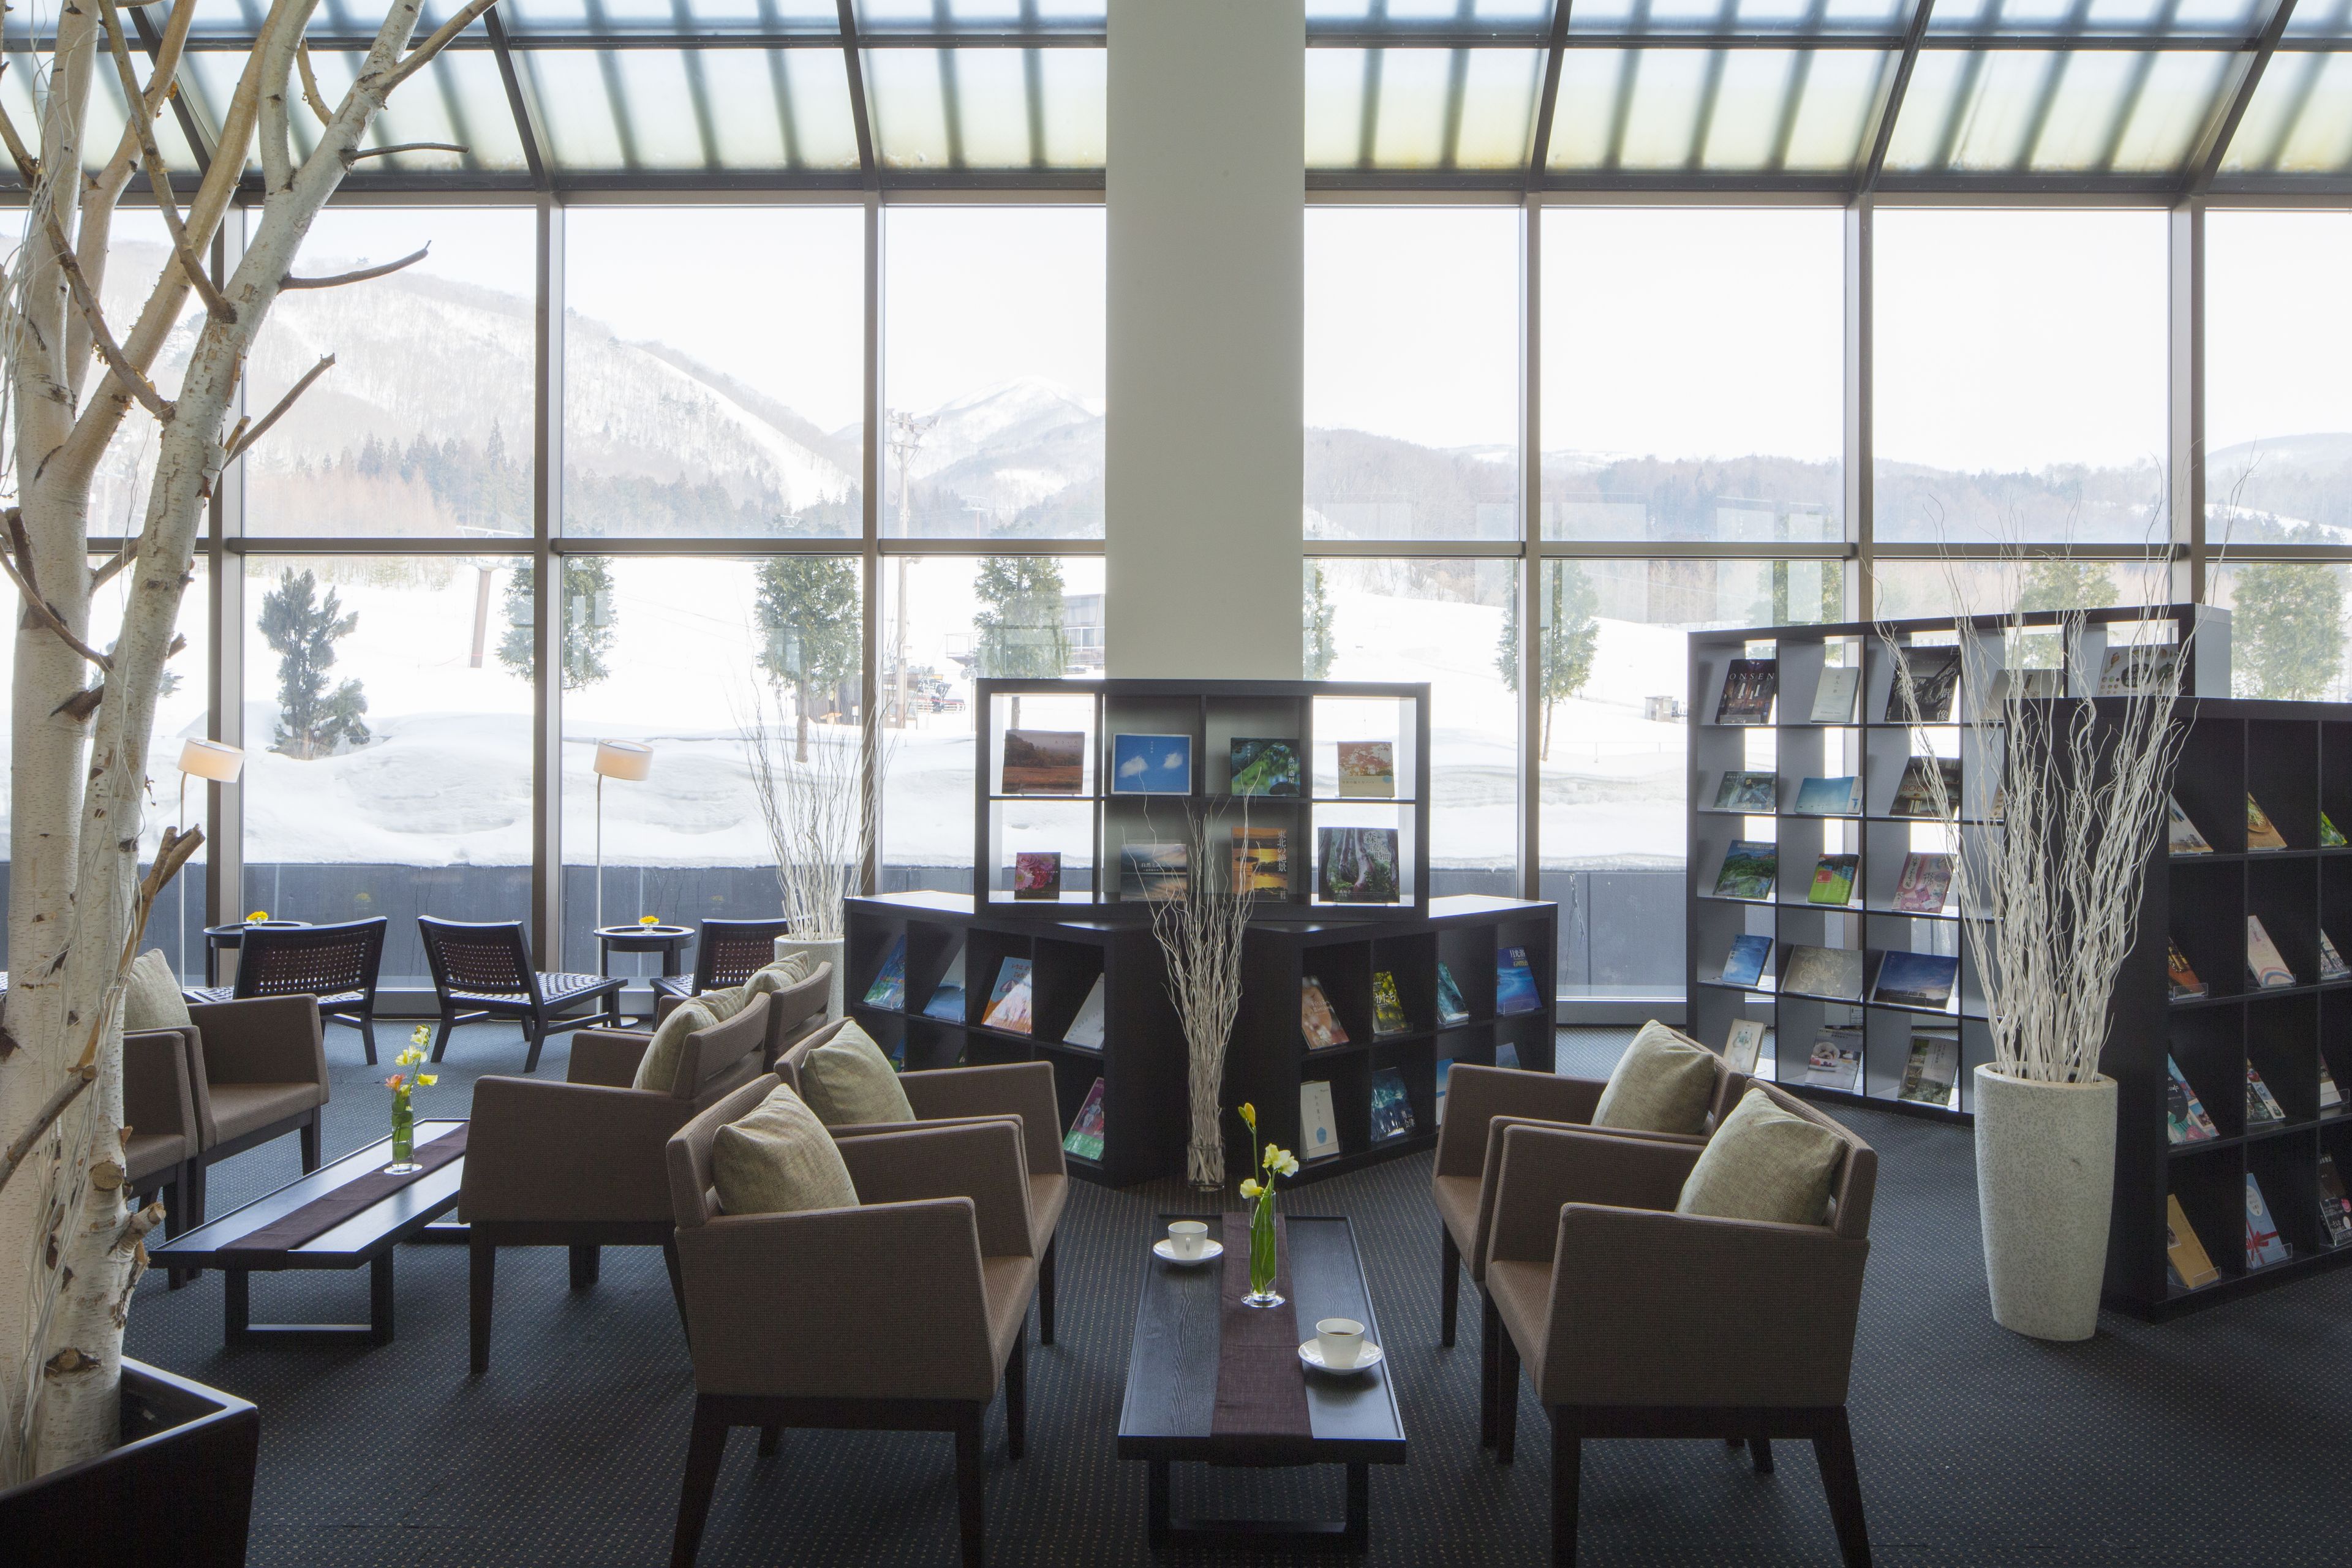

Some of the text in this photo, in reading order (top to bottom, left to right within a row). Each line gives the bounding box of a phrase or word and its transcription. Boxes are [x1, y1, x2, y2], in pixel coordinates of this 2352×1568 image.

[1277, 830, 1286, 872] 東北の絶景
[1375, 992, 1396, 1004] かたち
